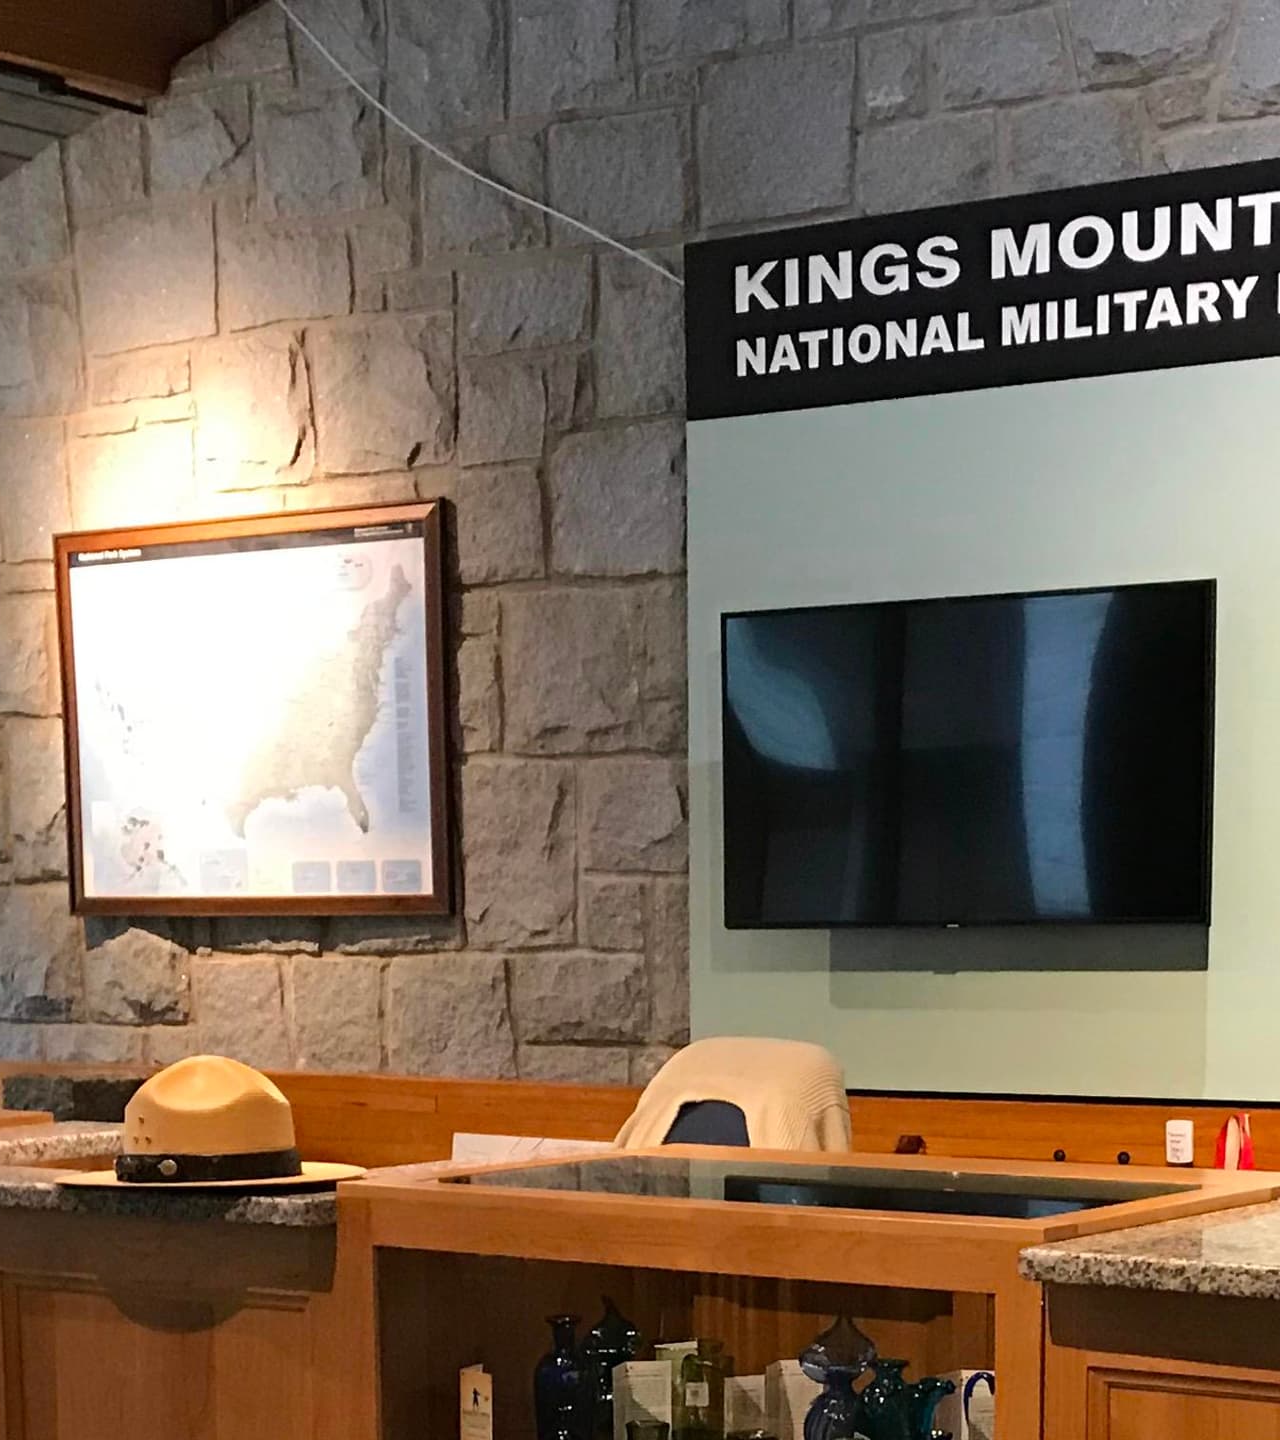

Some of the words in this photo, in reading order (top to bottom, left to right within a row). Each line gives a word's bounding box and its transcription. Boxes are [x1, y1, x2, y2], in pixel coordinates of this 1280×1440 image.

[734, 235, 961, 314] KINGS
[736, 311, 985, 377] NATIONAL
[1001, 275, 1259, 347] MILITARY
